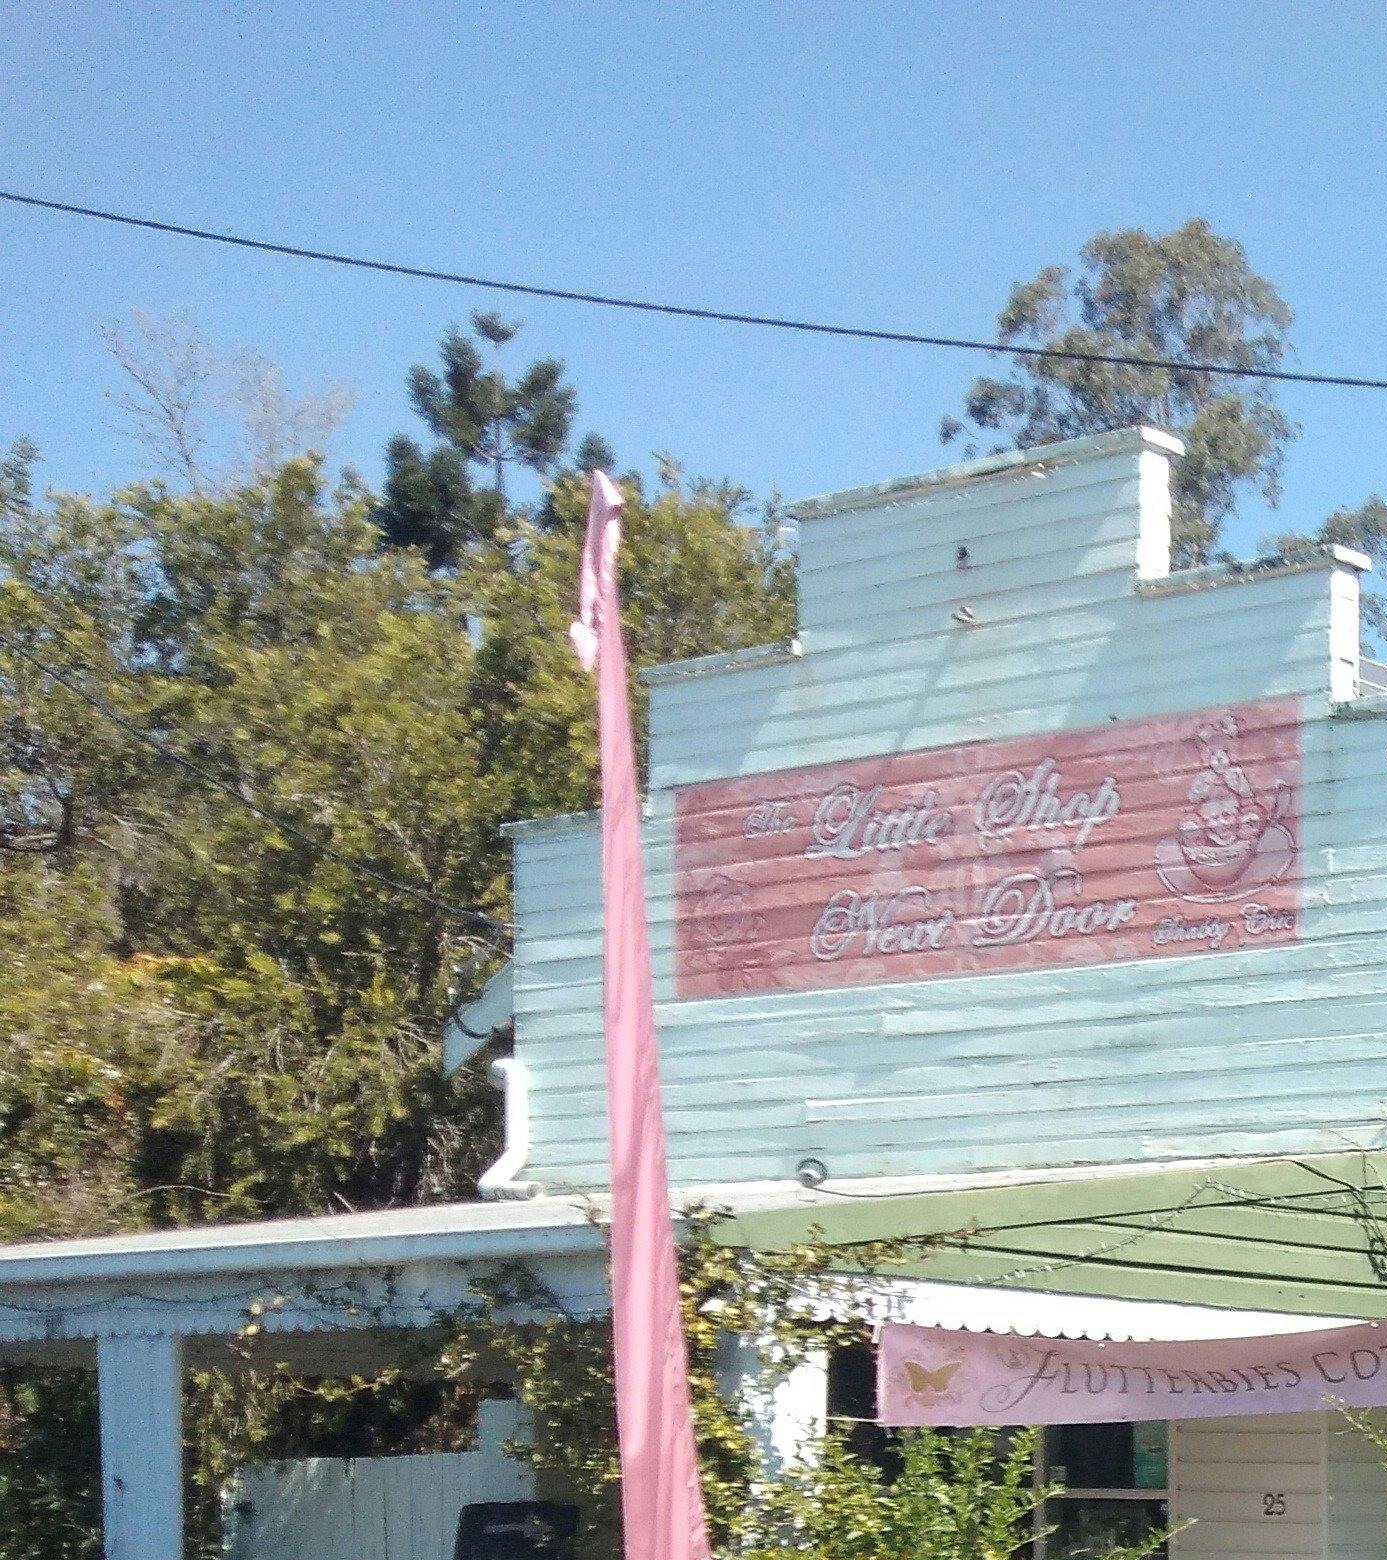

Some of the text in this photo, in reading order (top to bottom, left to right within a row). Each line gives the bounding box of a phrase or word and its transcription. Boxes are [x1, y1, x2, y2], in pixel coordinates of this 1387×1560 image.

[804, 780, 956, 860] Little
[974, 755, 1122, 854] Shop
[809, 864, 1140, 962] Next Door
[979, 1348, 1302, 1413] FLUTTERBIES
[1263, 1493, 1287, 1516] 25
